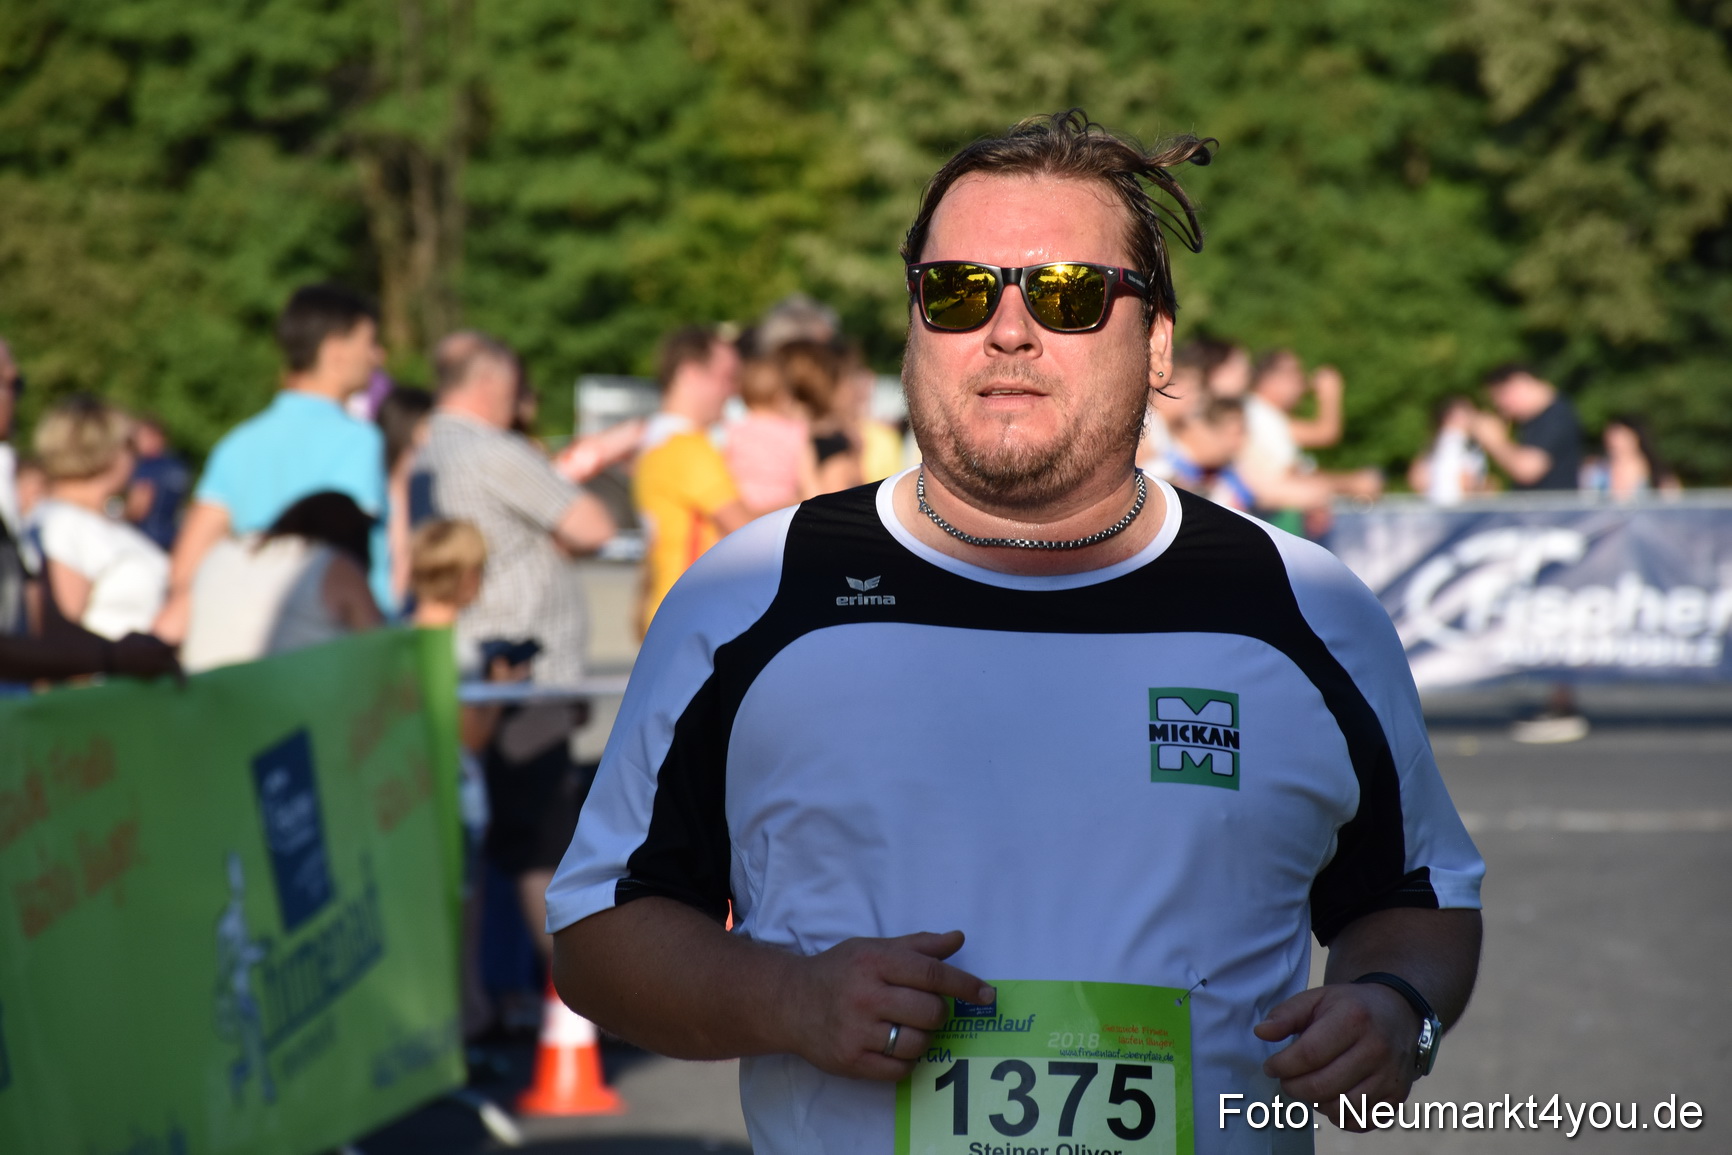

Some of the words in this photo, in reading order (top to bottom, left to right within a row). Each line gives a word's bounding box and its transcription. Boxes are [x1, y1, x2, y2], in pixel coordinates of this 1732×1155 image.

[836, 593, 896, 606] erima
[1148, 723, 1240, 750] MICKAN
[1048, 1032, 1099, 1049] 2018
[935, 1058, 1156, 1141] 1375
[969, 1142, 1049, 1155] Steiner
